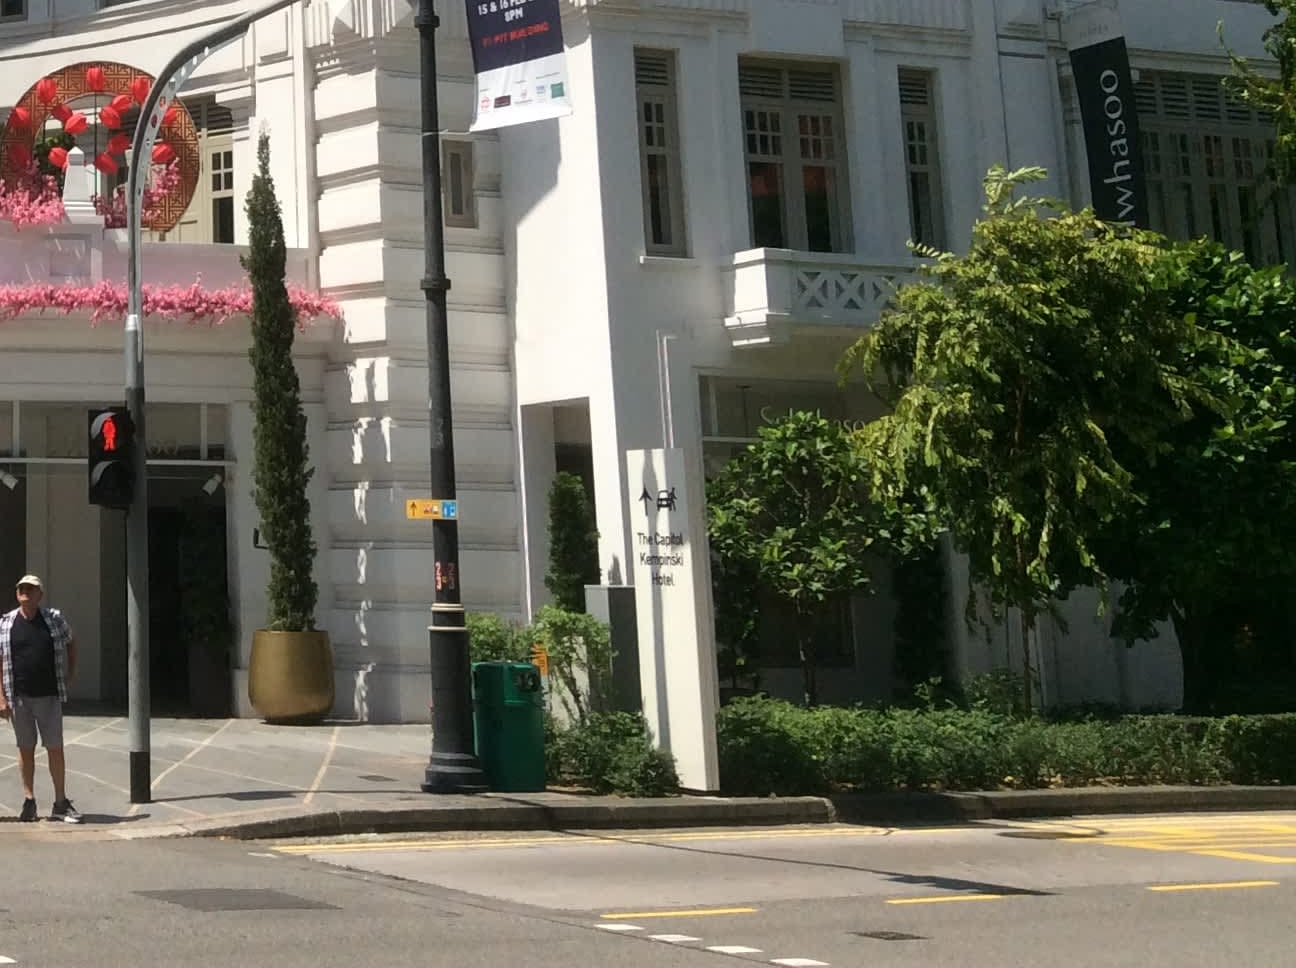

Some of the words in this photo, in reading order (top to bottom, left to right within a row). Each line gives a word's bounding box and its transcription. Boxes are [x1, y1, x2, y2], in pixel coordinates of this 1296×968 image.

[477, 3, 488, 15] 15
[489, 1, 498, 13] &
[504, 7, 523, 22] 8PM
[637, 532, 653, 546] The
[654, 532, 683, 548] Capitol
[639, 552, 684, 569] Kempinski
[652, 573, 674, 586] Hotel
